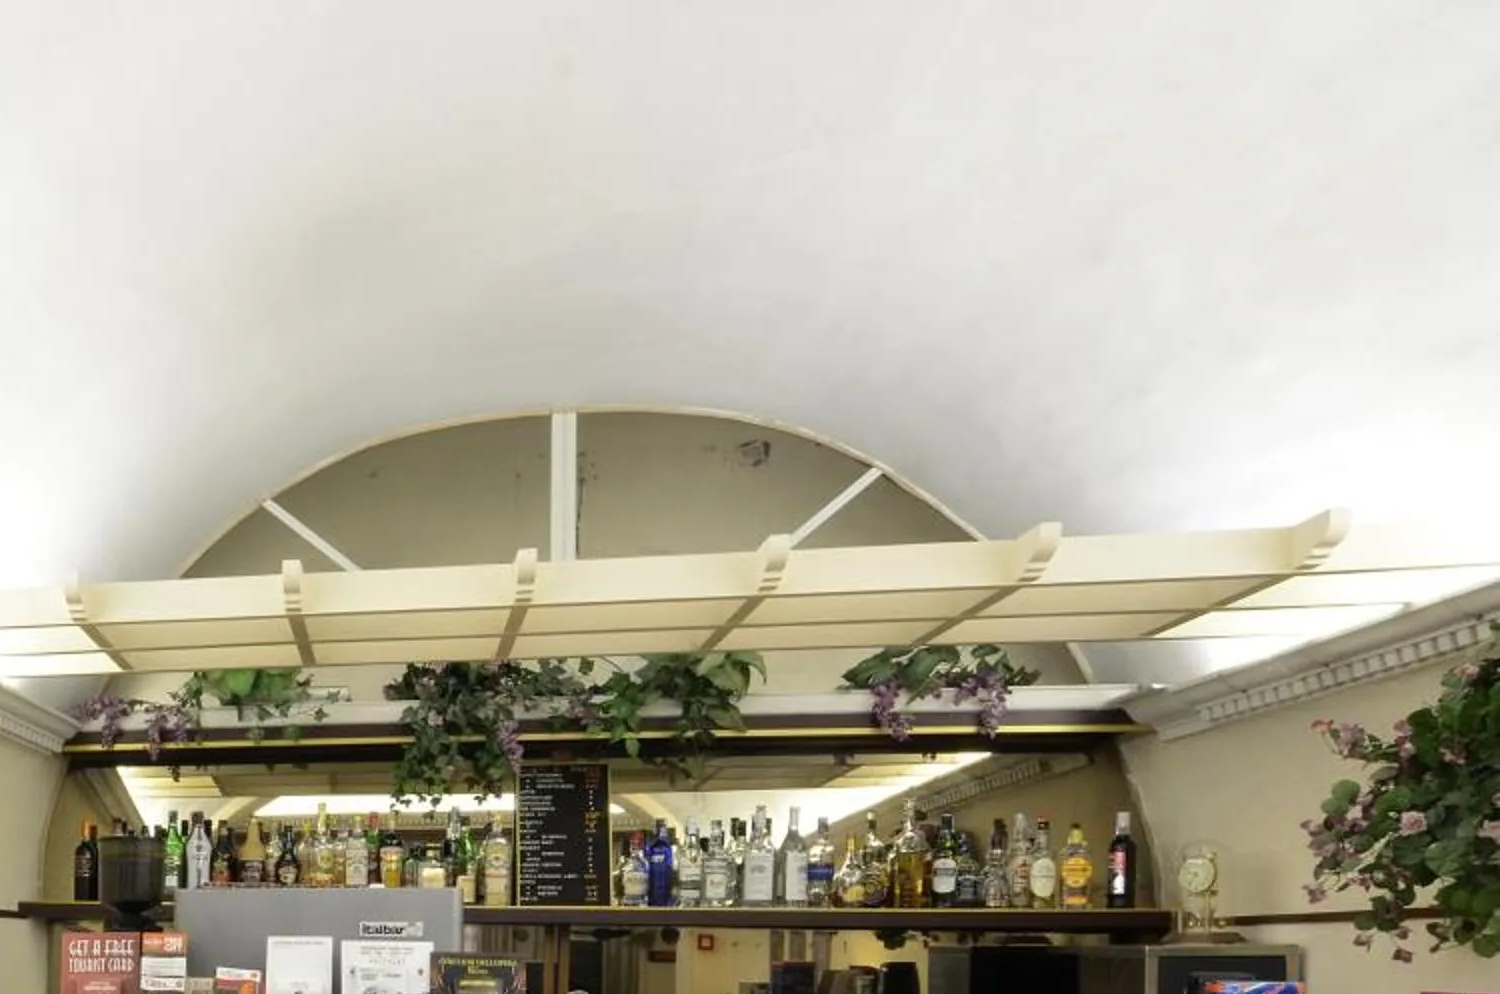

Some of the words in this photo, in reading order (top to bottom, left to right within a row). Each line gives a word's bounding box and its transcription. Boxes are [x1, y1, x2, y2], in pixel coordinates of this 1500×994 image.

[68, 939, 89, 956] GET
[92, 939, 101, 956] A
[104, 939, 135, 956] FREE
[69, 957, 106, 973] TOURIST
[107, 957, 135, 973] CARD
